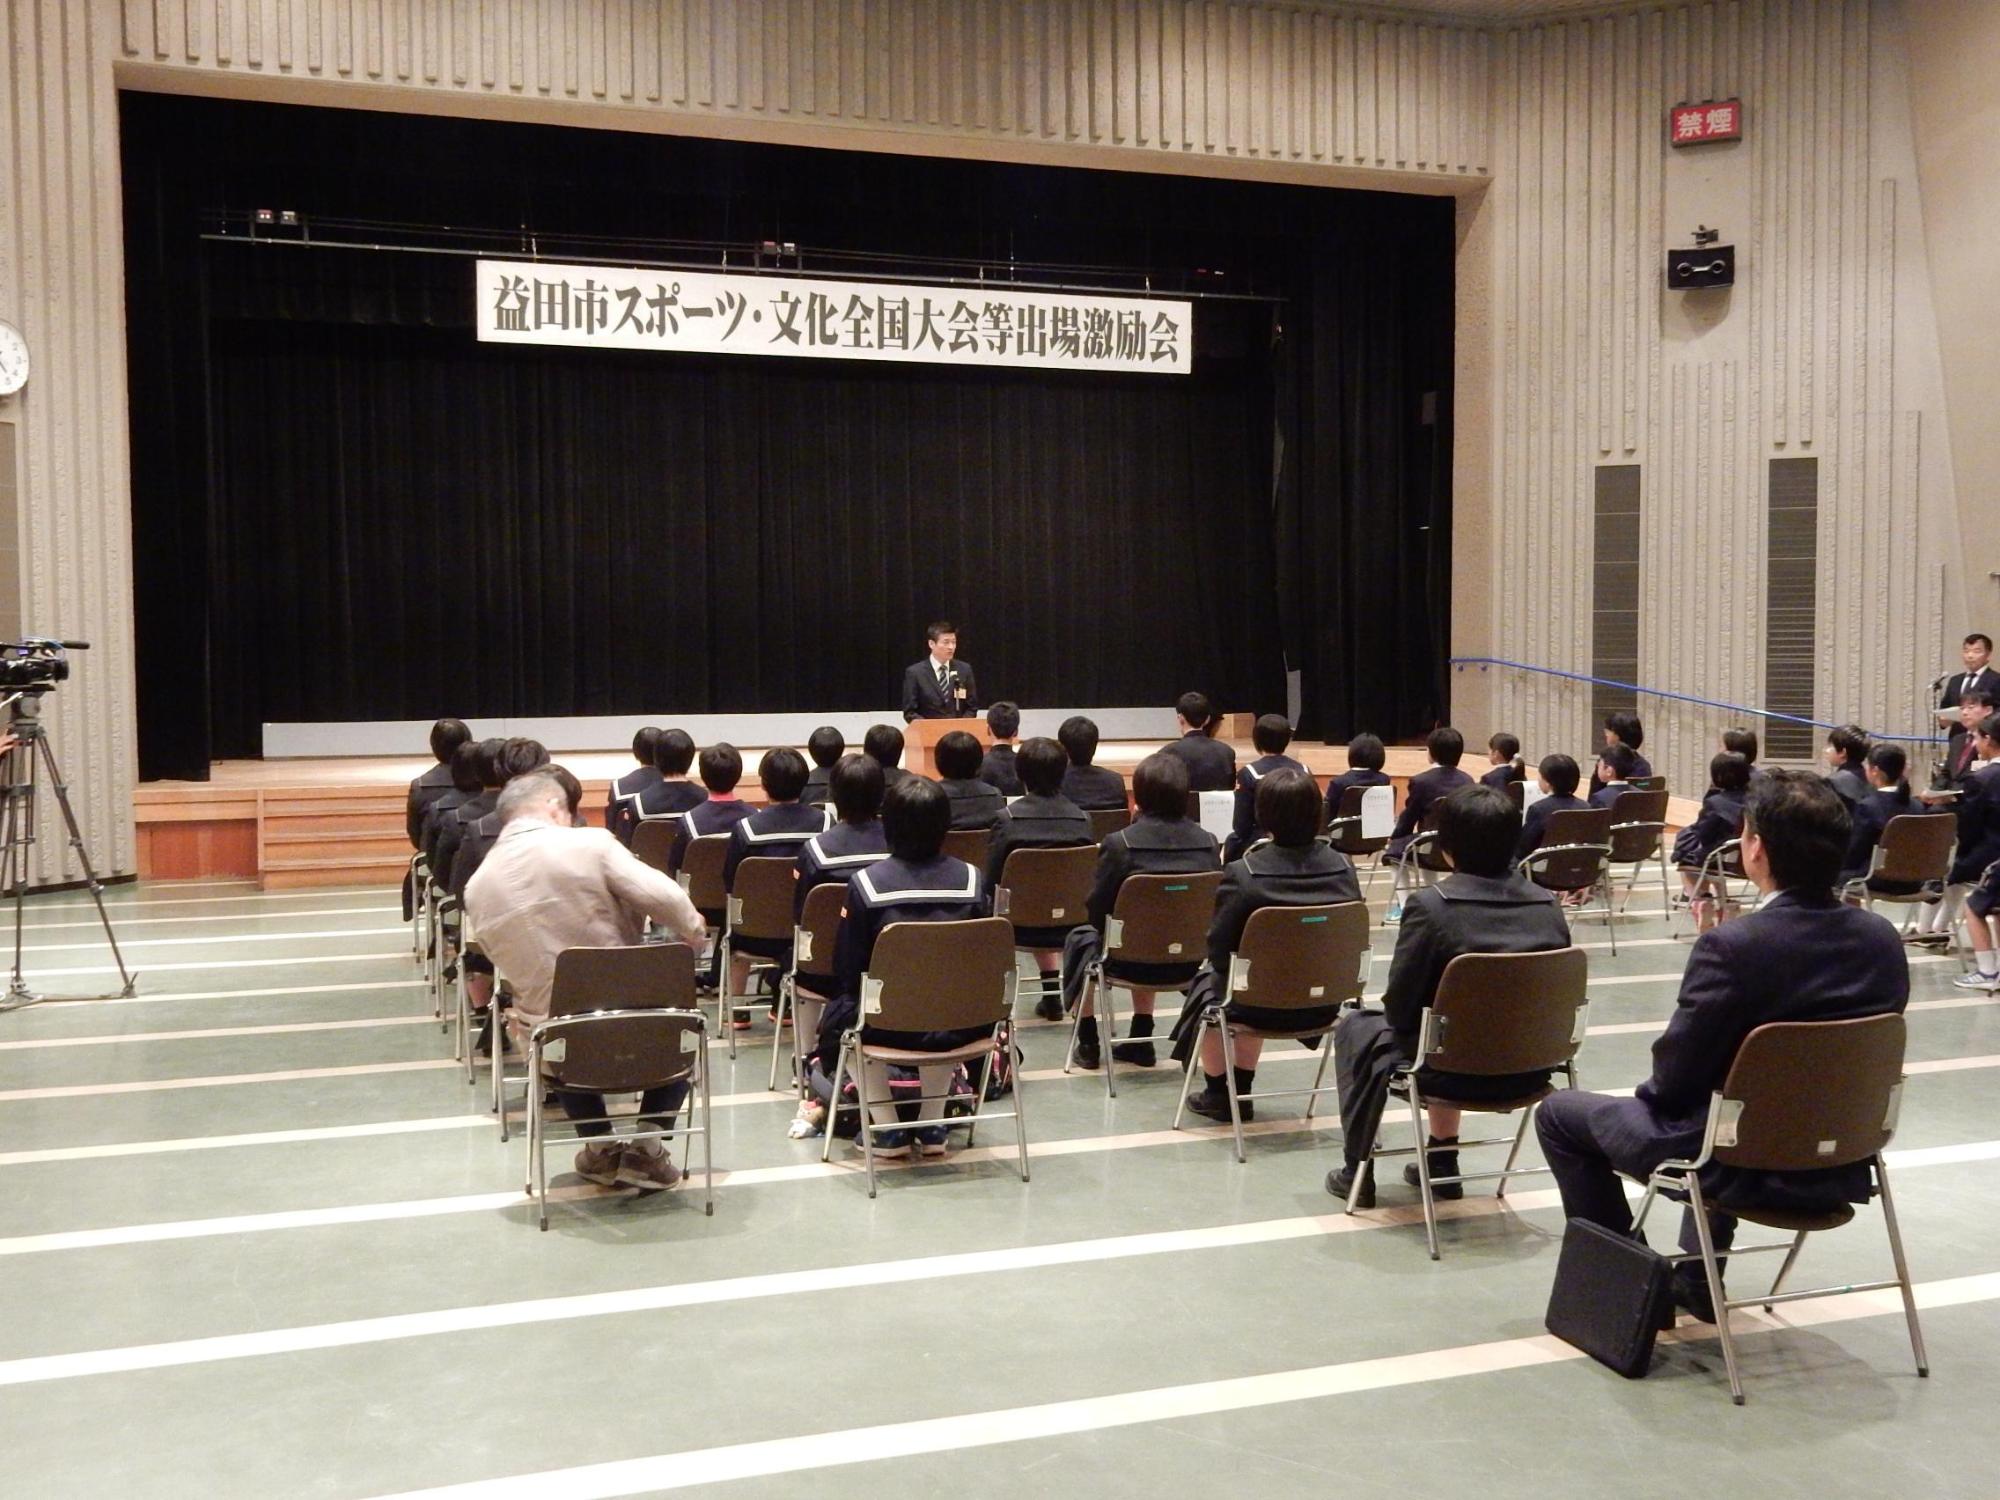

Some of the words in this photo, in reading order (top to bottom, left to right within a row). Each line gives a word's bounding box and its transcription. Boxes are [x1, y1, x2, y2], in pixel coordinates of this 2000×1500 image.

[1677, 107, 1732, 138] 禁煙
[493, 275, 1179, 363] 益田市スポーツ・文化全国大会等出場激励会
